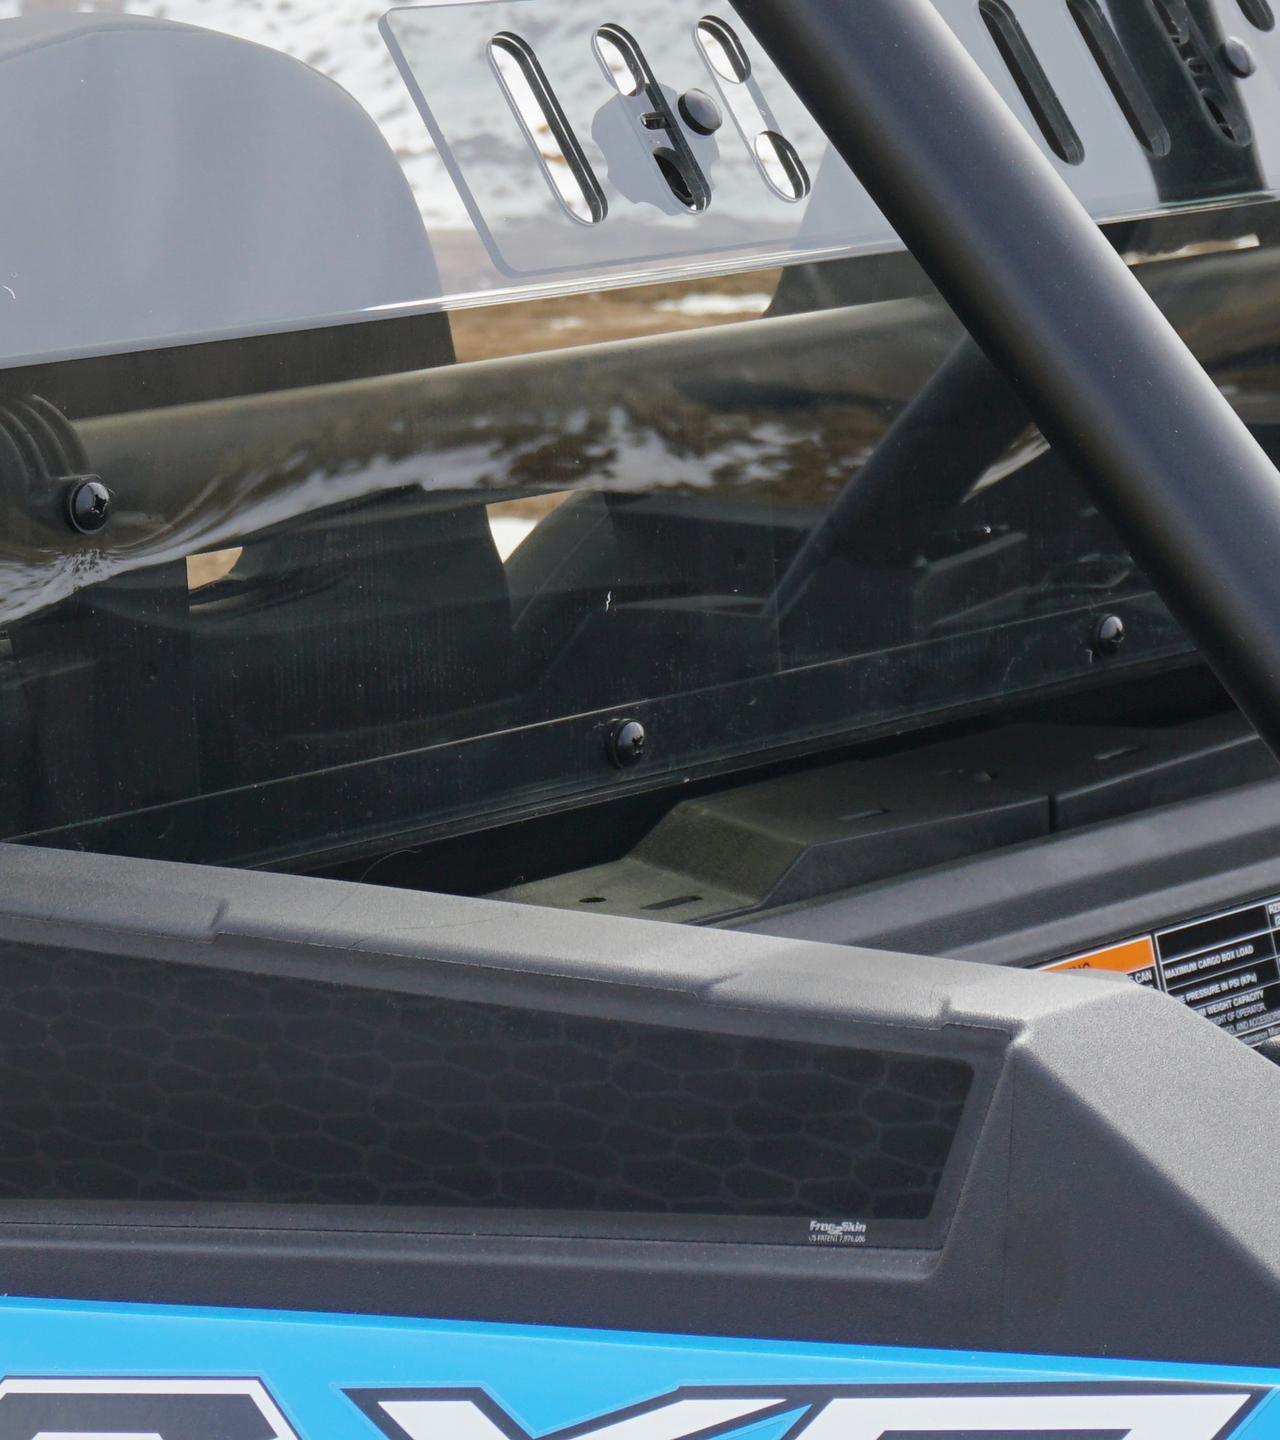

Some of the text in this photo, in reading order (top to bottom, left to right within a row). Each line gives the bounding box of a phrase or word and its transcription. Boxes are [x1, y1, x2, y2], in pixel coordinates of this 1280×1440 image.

[1164, 945, 1254, 979] MAXIMUM CARGO BOX LOAD
[1135, 969, 1153, 984] CAN
[1186, 985, 1220, 1003] PRESSURE
[1220, 982, 1228, 992] IN
[1228, 979, 1239, 989] PSI
[1240, 972, 1258, 988] (KPa)
[1206, 1000, 1232, 1016] WEIGHT
[1233, 990, 1264, 1007] CAPACITY
[1227, 1011, 1235, 1021] OF
[1236, 1003, 1267, 1019] OPERATOR,
[1236, 1022, 1249, 1033] AND
[817, 1234, 838, 1242] PATENT
